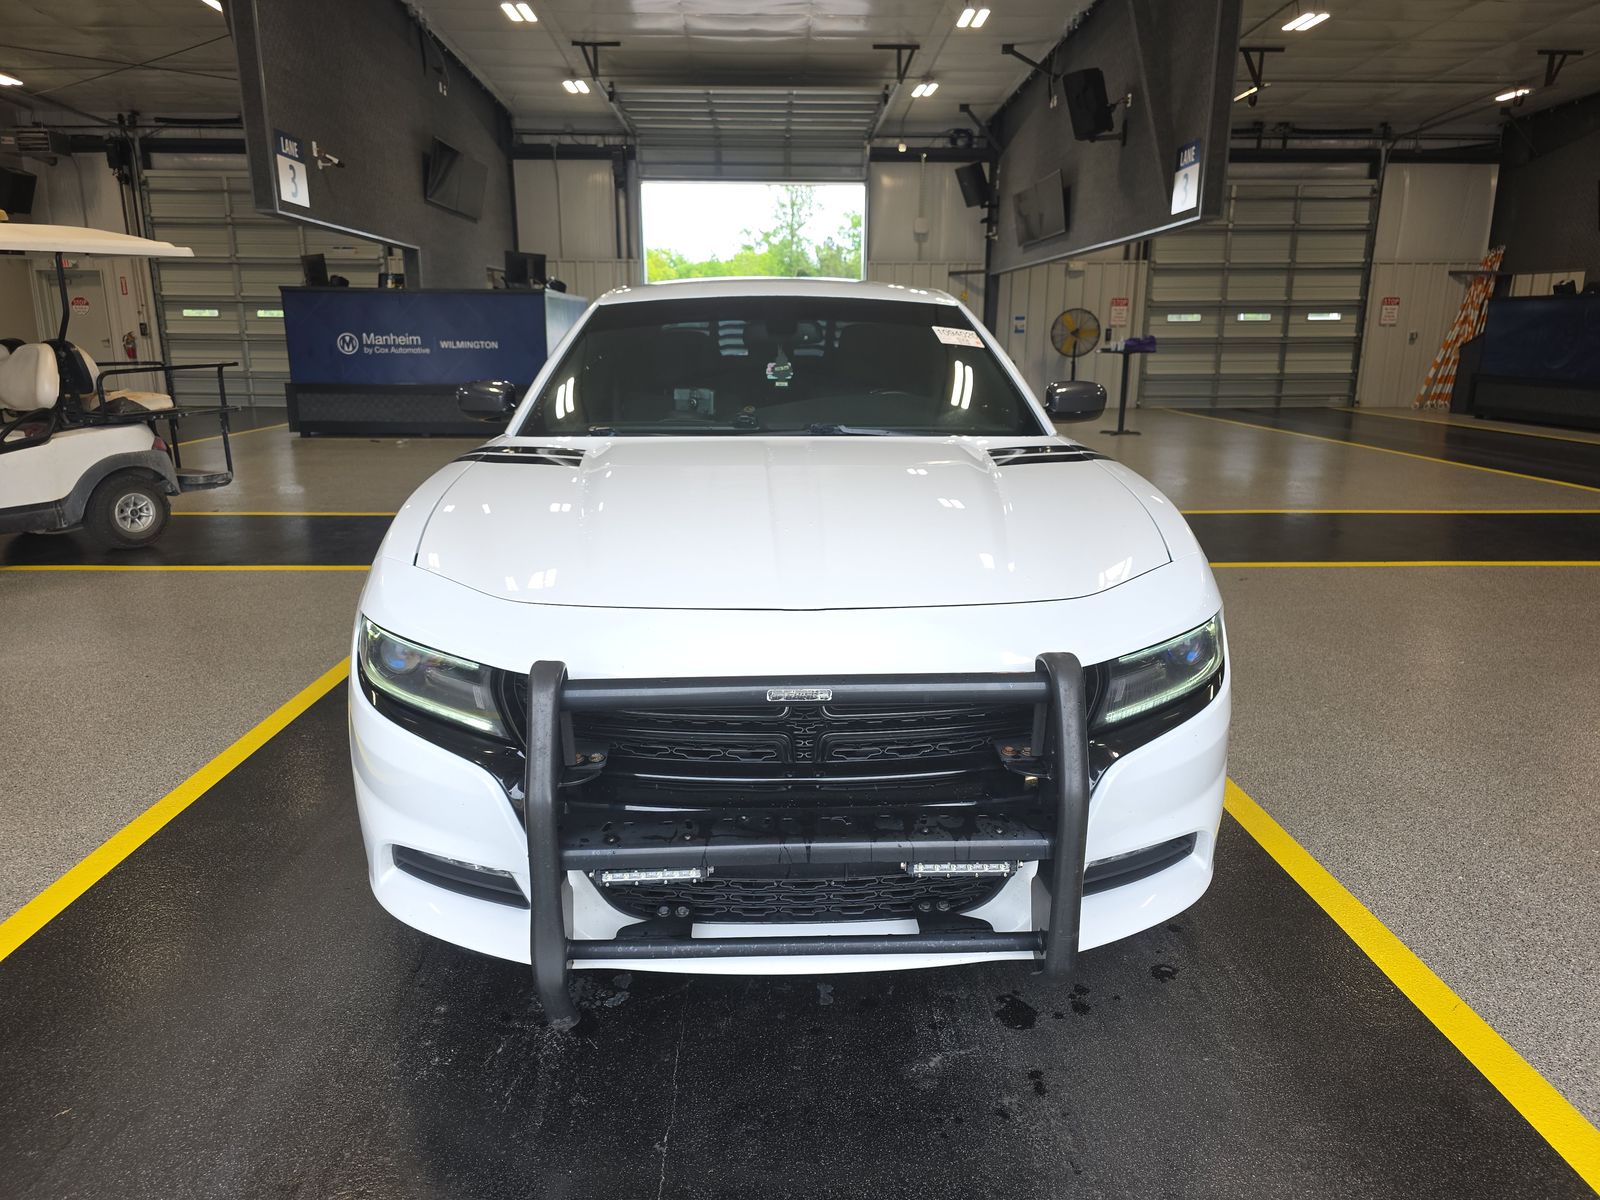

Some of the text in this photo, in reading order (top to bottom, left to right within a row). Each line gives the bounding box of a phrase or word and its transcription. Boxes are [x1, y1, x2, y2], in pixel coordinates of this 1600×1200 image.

[280, 136, 298, 158] LANE
[1180, 146, 1196, 167] LANE
[288, 164, 298, 198] 3
[362, 333, 421, 345] Manheim
[440, 340, 499, 349] WILMINGTON
[364, 346, 430, 355] by Cox Automotive
